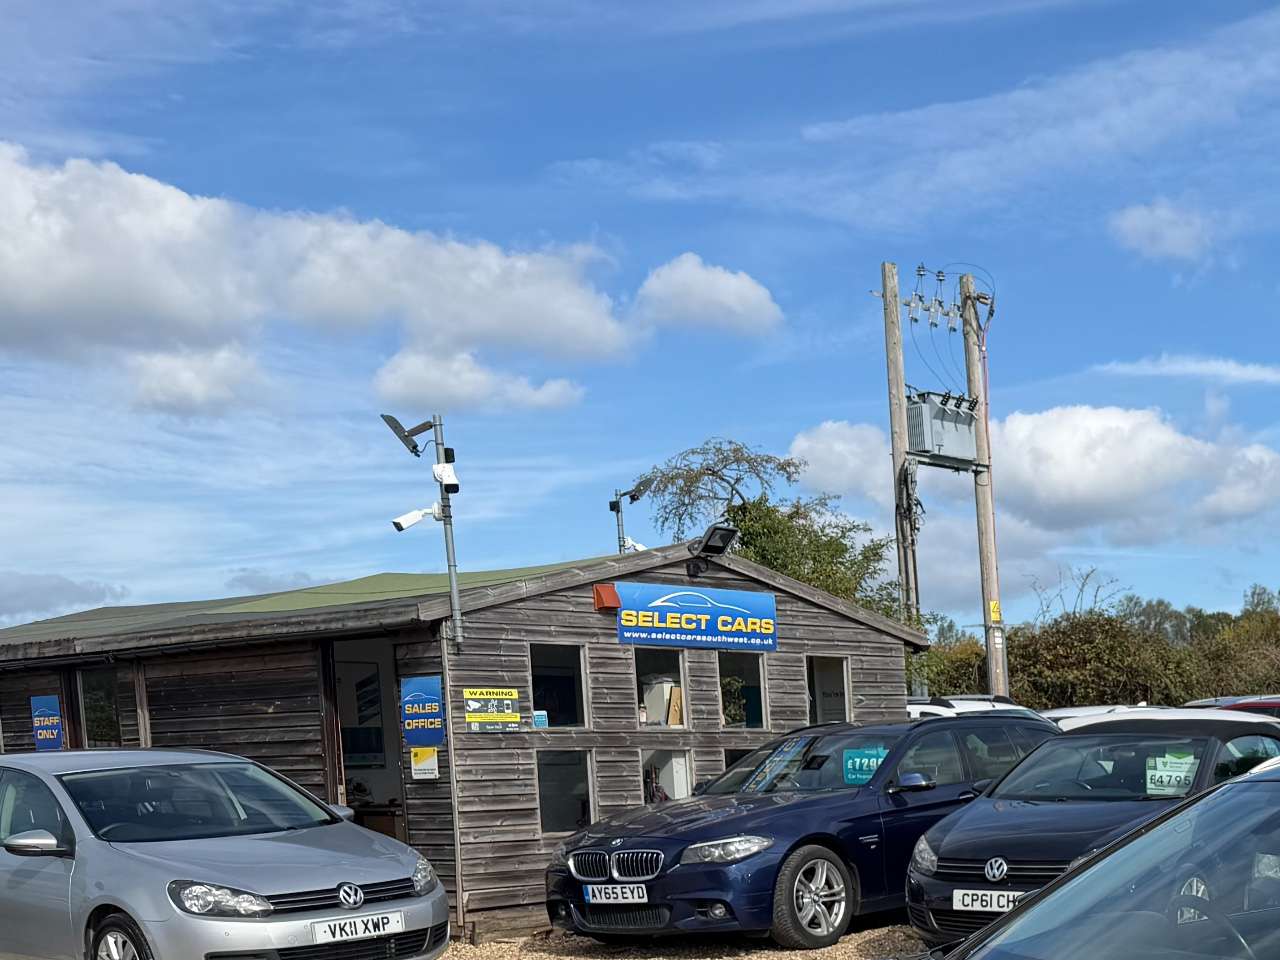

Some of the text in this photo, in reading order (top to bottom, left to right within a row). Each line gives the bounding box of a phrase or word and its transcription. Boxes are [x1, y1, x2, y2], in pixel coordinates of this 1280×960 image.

[620, 610, 775, 634] SELECT CARS
[623, 631, 774, 645] www.selectcarssouthwest.co.uk
[405, 703, 439, 714] SALES
[34, 717, 60, 726] STAFF
[405, 719, 442, 730] OFFICE
[37, 730, 58, 739] ONLY
[1150, 774, 1191, 786] £4795
[592, 886, 645, 900] AY65 EYD
[962, 893, 1018, 909] CP61 CH
[328, 916, 390, 939] VK11 XWP
